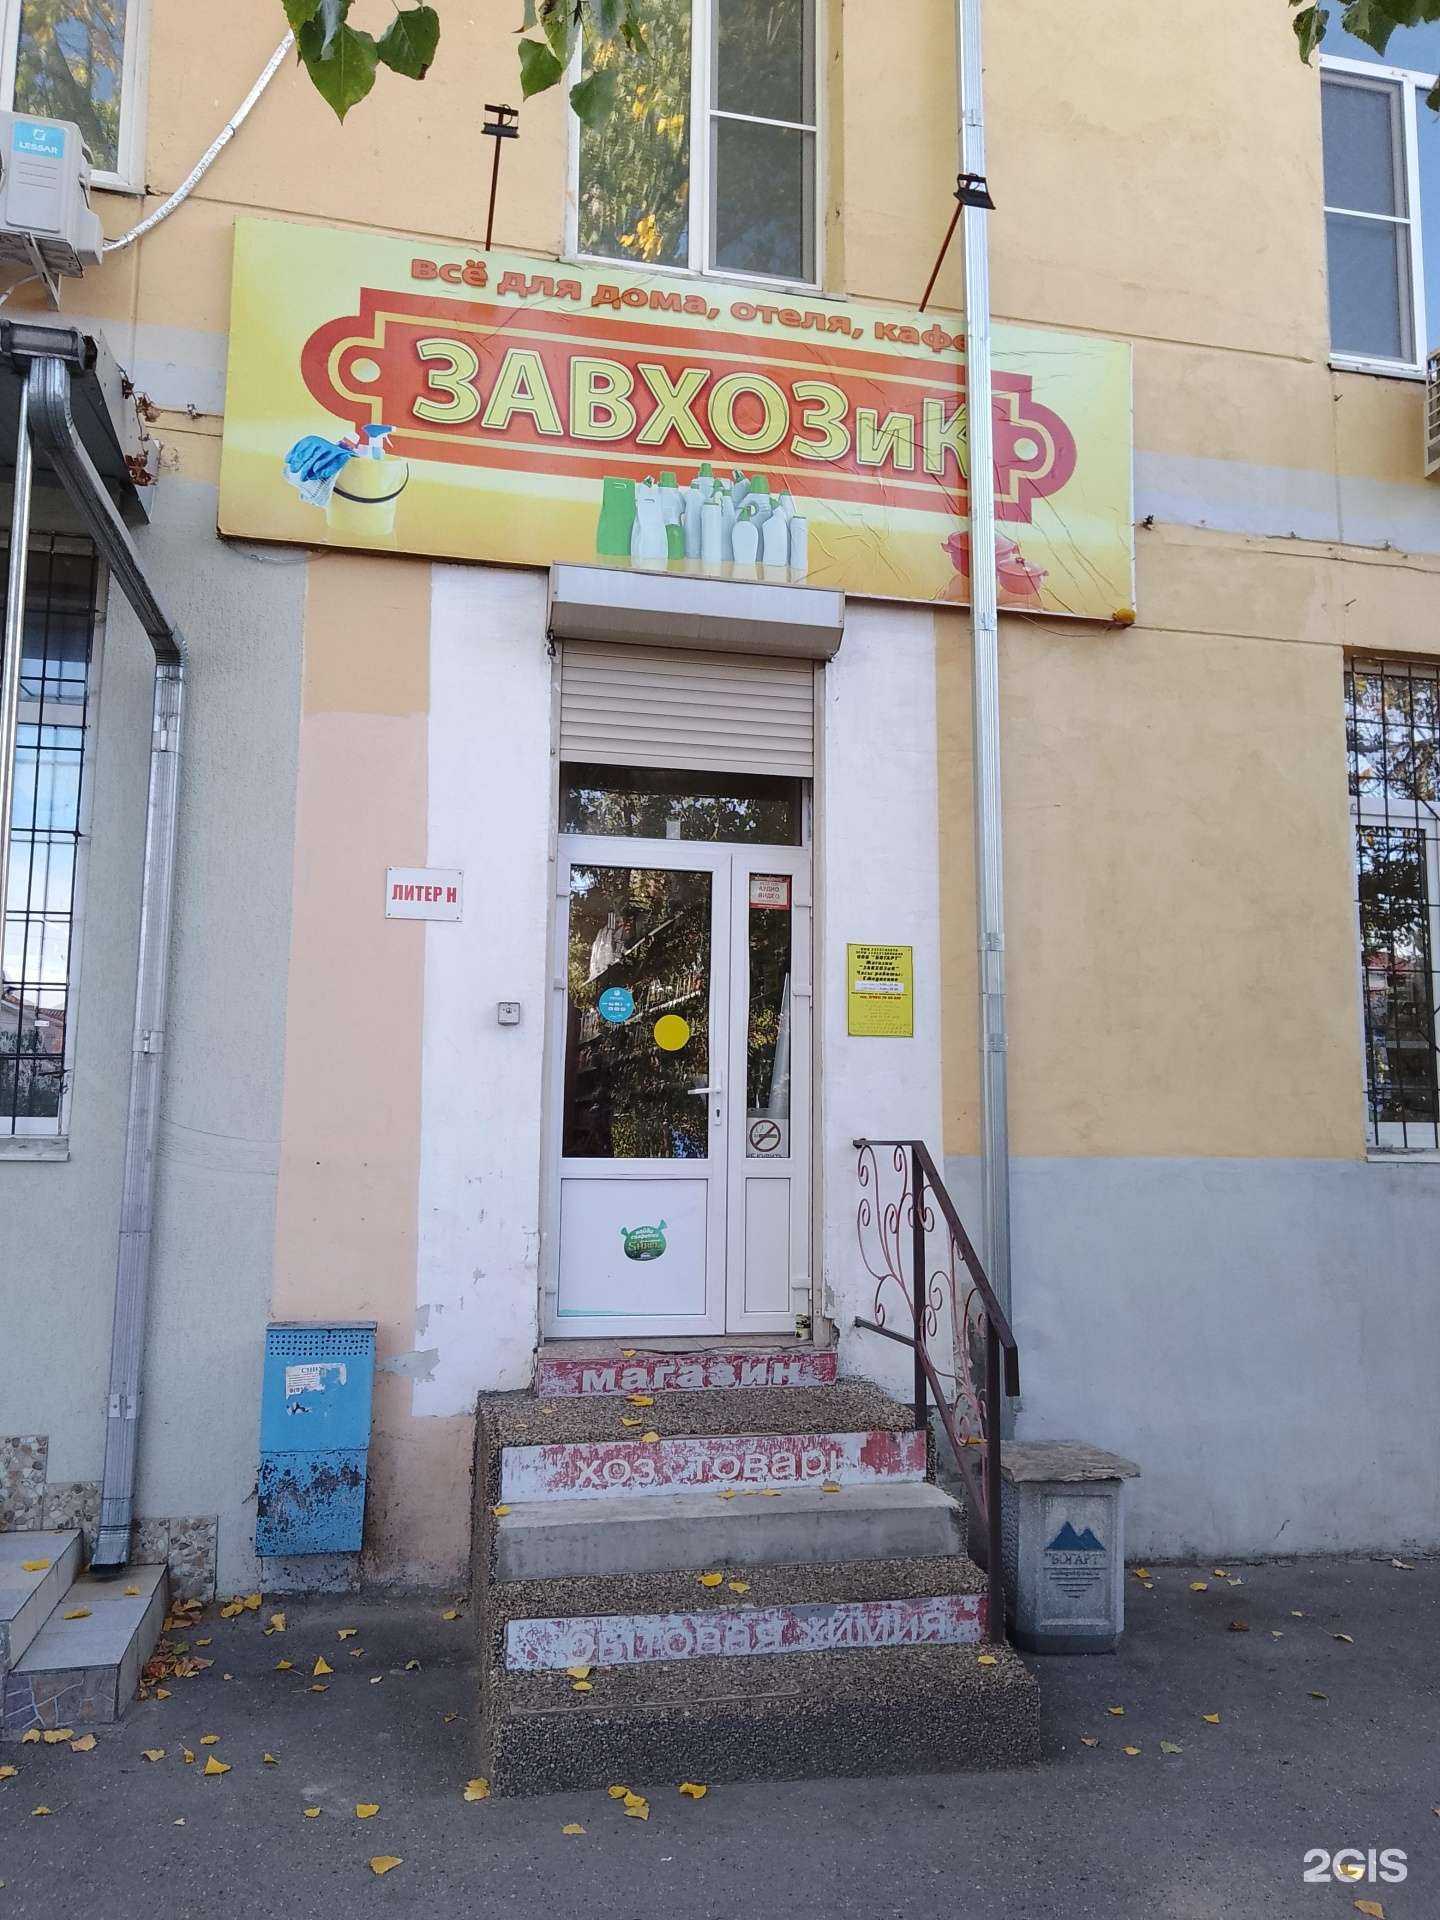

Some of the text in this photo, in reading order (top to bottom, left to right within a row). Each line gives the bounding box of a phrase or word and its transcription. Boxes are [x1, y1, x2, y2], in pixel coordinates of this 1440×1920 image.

[411, 258, 488, 288] всё
[497, 271, 582, 298] для
[591, 284, 720, 320] дома,
[730, 301, 863, 340] отеля,
[392, 884, 457, 903] ЛИТЕР Н
[583, 1361, 801, 1393] магазин
